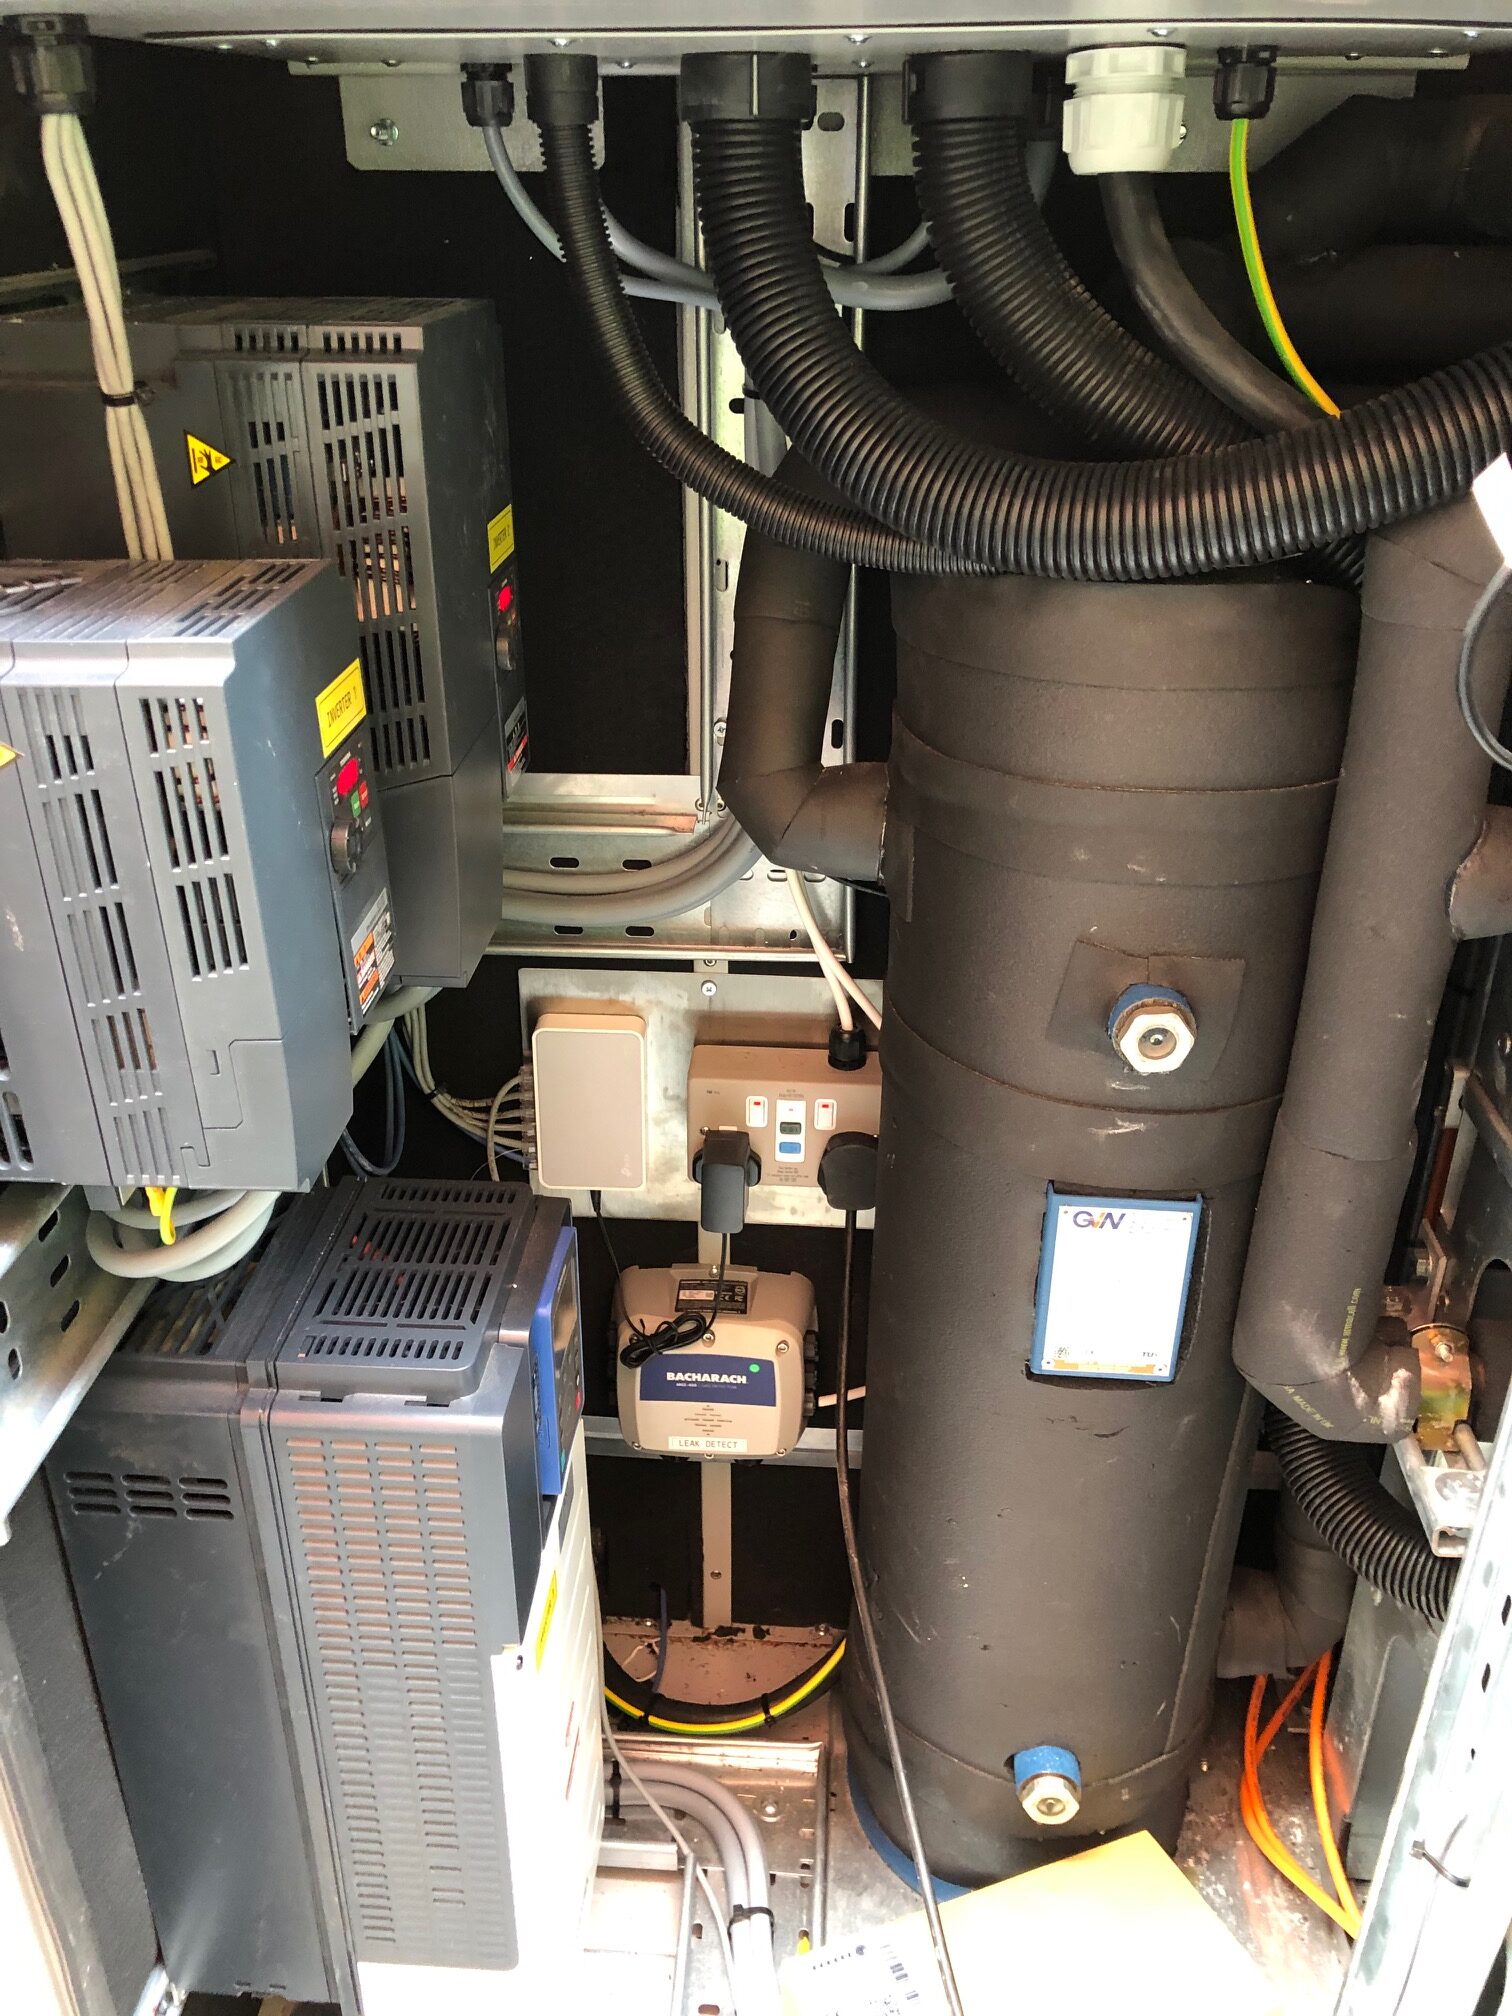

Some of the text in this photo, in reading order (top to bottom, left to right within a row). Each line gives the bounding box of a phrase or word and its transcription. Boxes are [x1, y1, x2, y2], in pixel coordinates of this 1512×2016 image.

[326, 685, 358, 728] INVERTER 1
[666, 1372, 747, 1384] BACHARACH
[1292, 1395, 1317, 1413] MADE
[679, 1439, 738, 1449] LEAK DETECT
